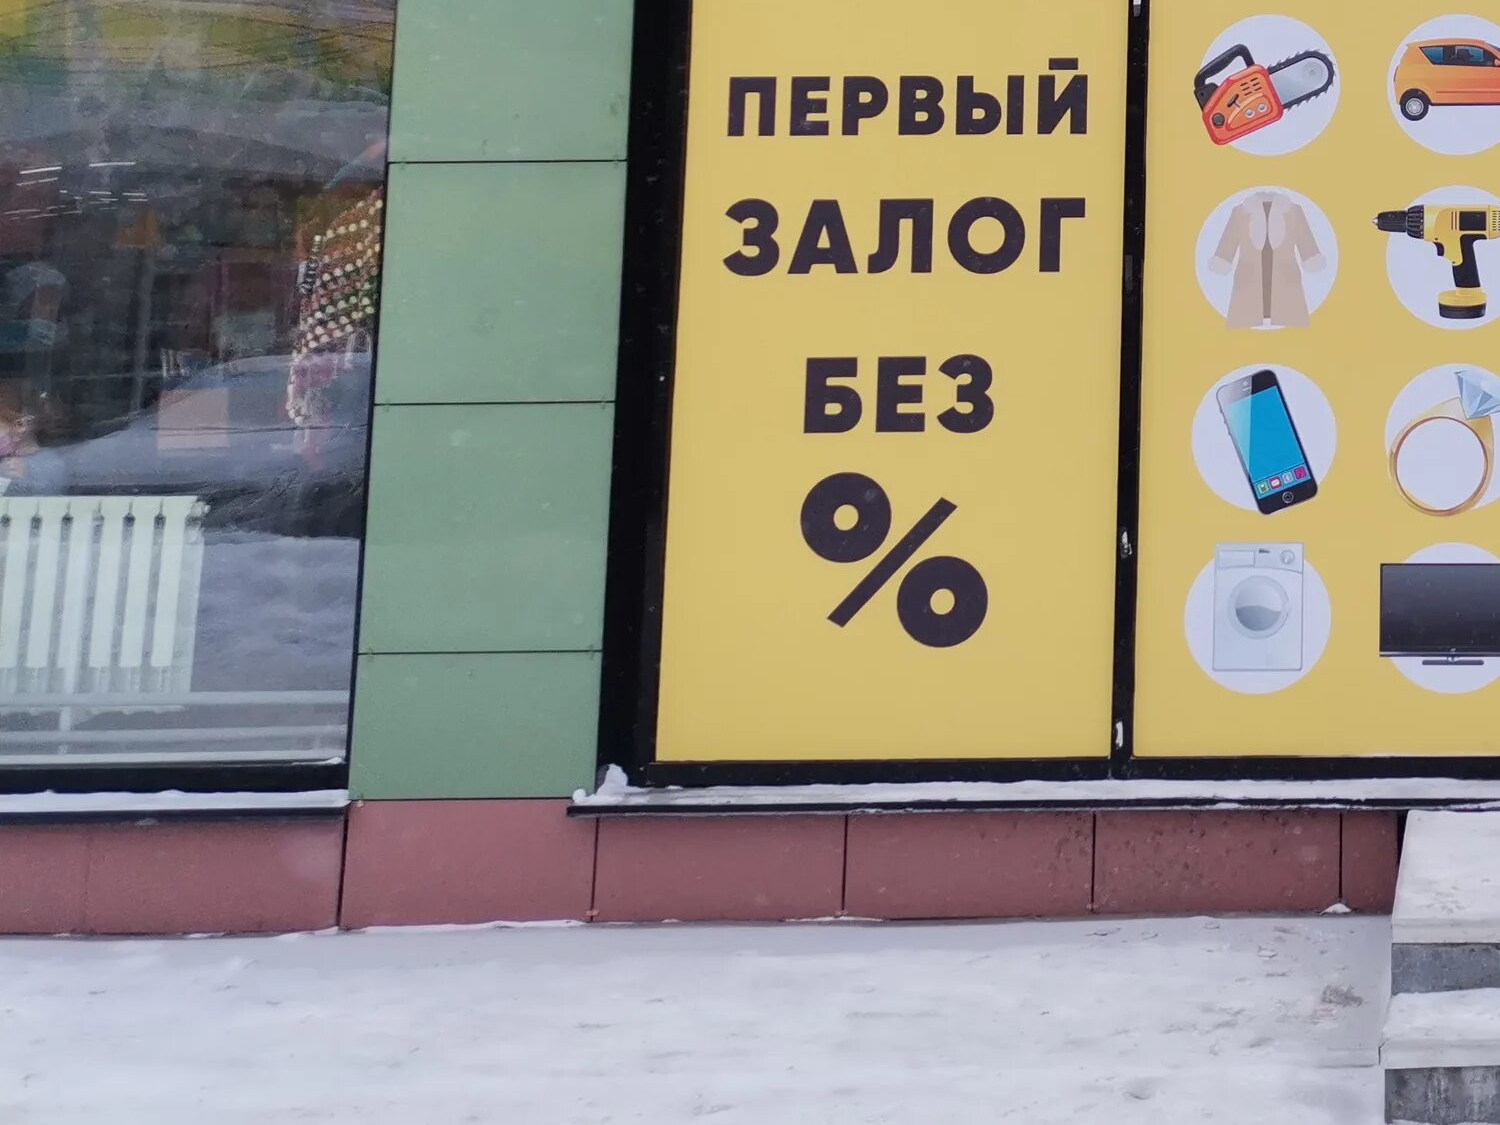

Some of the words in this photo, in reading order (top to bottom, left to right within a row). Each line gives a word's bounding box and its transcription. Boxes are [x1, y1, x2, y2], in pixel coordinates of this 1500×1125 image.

[725, 56, 1087, 137] ПЕРВЫЙ
[722, 195, 1086, 277] ЗАЛОГ
[803, 353, 995, 435] БЕЗ
[799, 470, 988, 649] %
